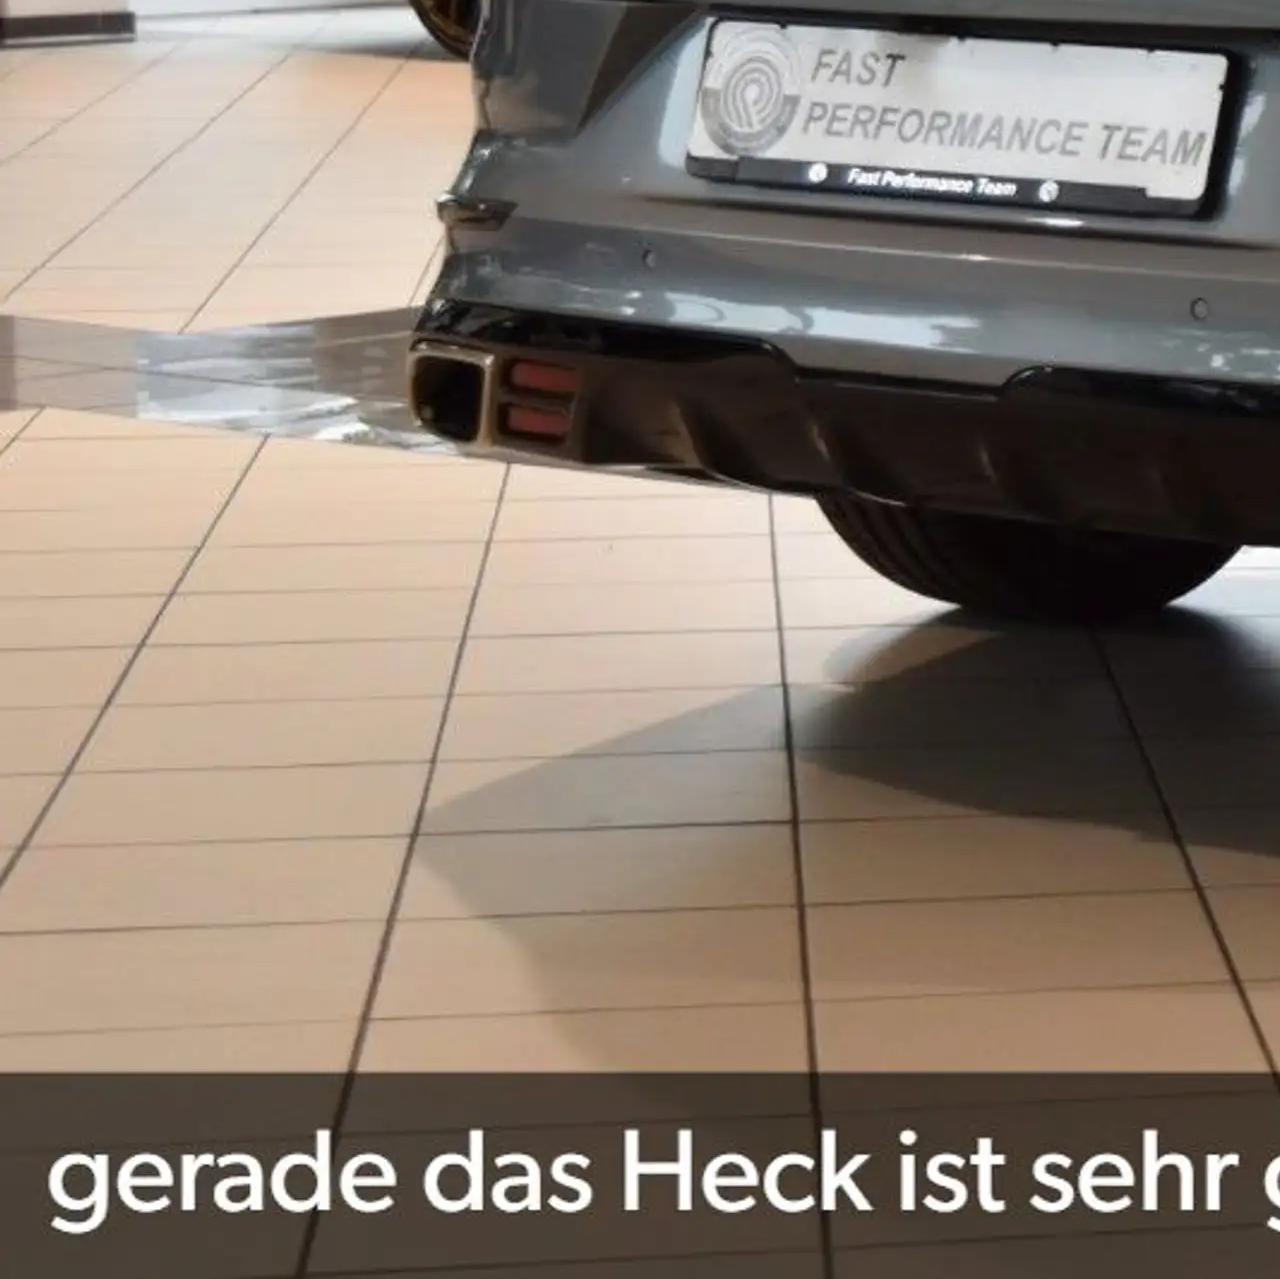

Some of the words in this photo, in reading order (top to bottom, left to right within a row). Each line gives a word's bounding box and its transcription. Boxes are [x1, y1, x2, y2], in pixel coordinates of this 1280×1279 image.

[810, 48, 906, 89] FAST
[802, 101, 1090, 158] PERFORMANCE
[1097, 124, 1208, 167] TEAM
[847, 167, 882, 186] Fast
[882, 170, 974, 194] Performance
[976, 178, 1017, 196] Team
